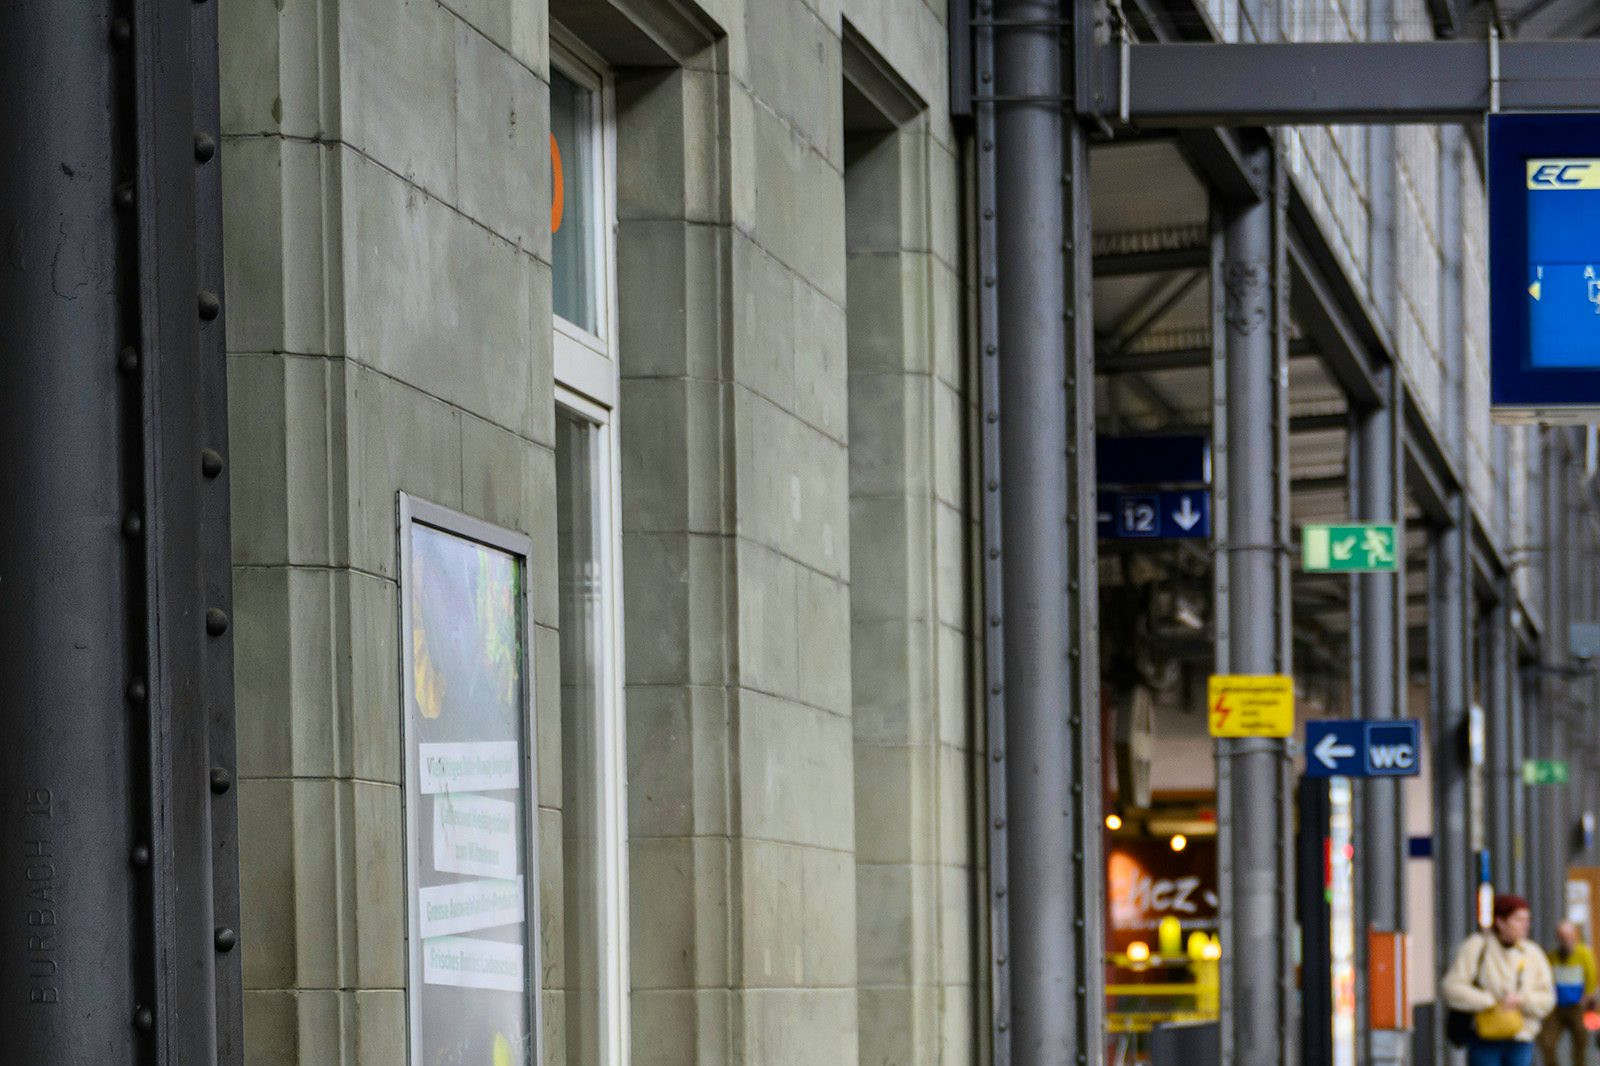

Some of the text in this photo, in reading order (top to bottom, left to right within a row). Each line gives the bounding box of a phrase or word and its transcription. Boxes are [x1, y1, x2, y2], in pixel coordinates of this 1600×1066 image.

[1532, 164, 1592, 185] EC
[1584, 265, 1596, 280] A
[1122, 506, 1155, 532] 12
[1368, 744, 1414, 769] WC
[24, 786, 59, 1005] BURBACH 15
